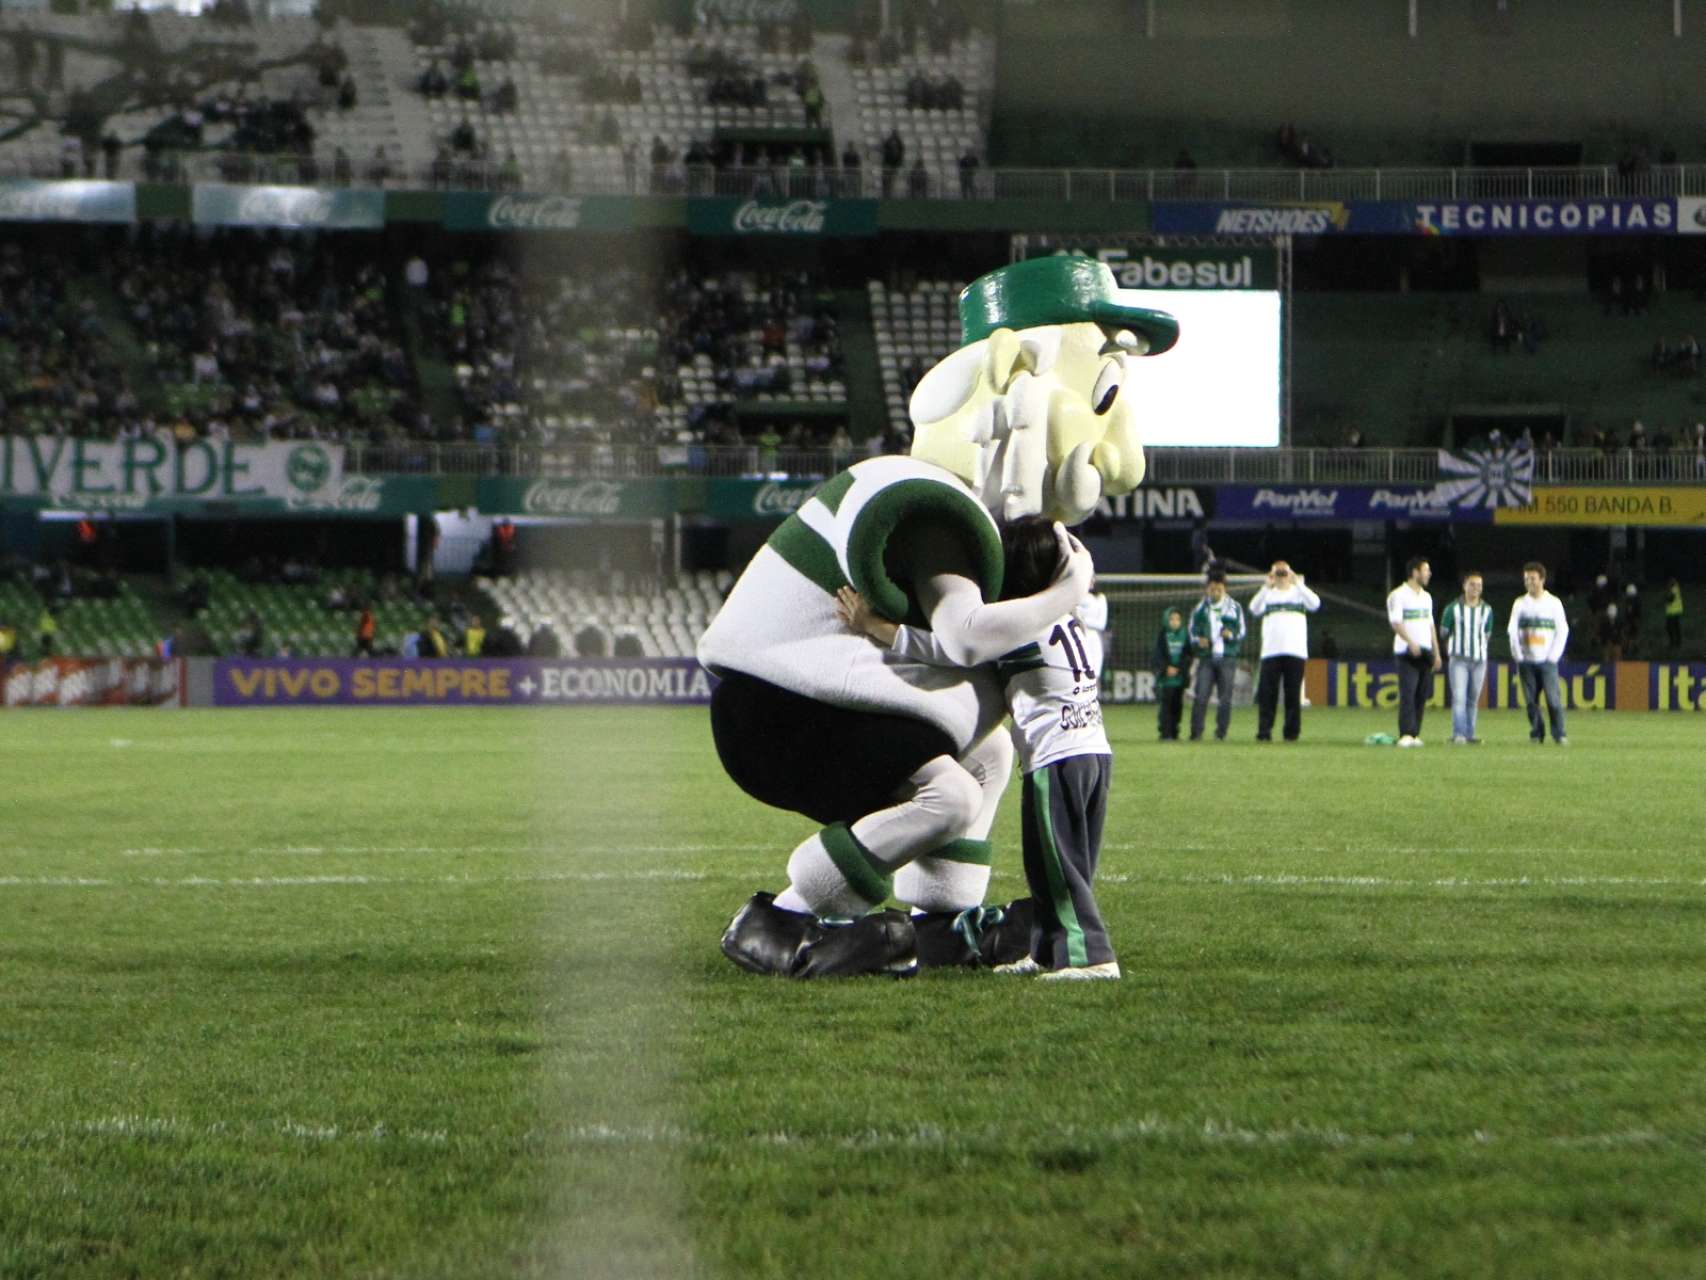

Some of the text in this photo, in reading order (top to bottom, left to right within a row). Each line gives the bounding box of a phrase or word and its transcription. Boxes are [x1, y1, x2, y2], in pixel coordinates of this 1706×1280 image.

[1216, 209, 1329, 234] NETSHOES
[1415, 203, 1672, 228] TECNICOPIAS
[1098, 248, 1252, 288] Fabesul
[1545, 495, 1579, 514] 550
[1584, 495, 1655, 514] BANDA
[231, 668, 340, 697] VIVO
[351, 667, 512, 697] SEMPRE
